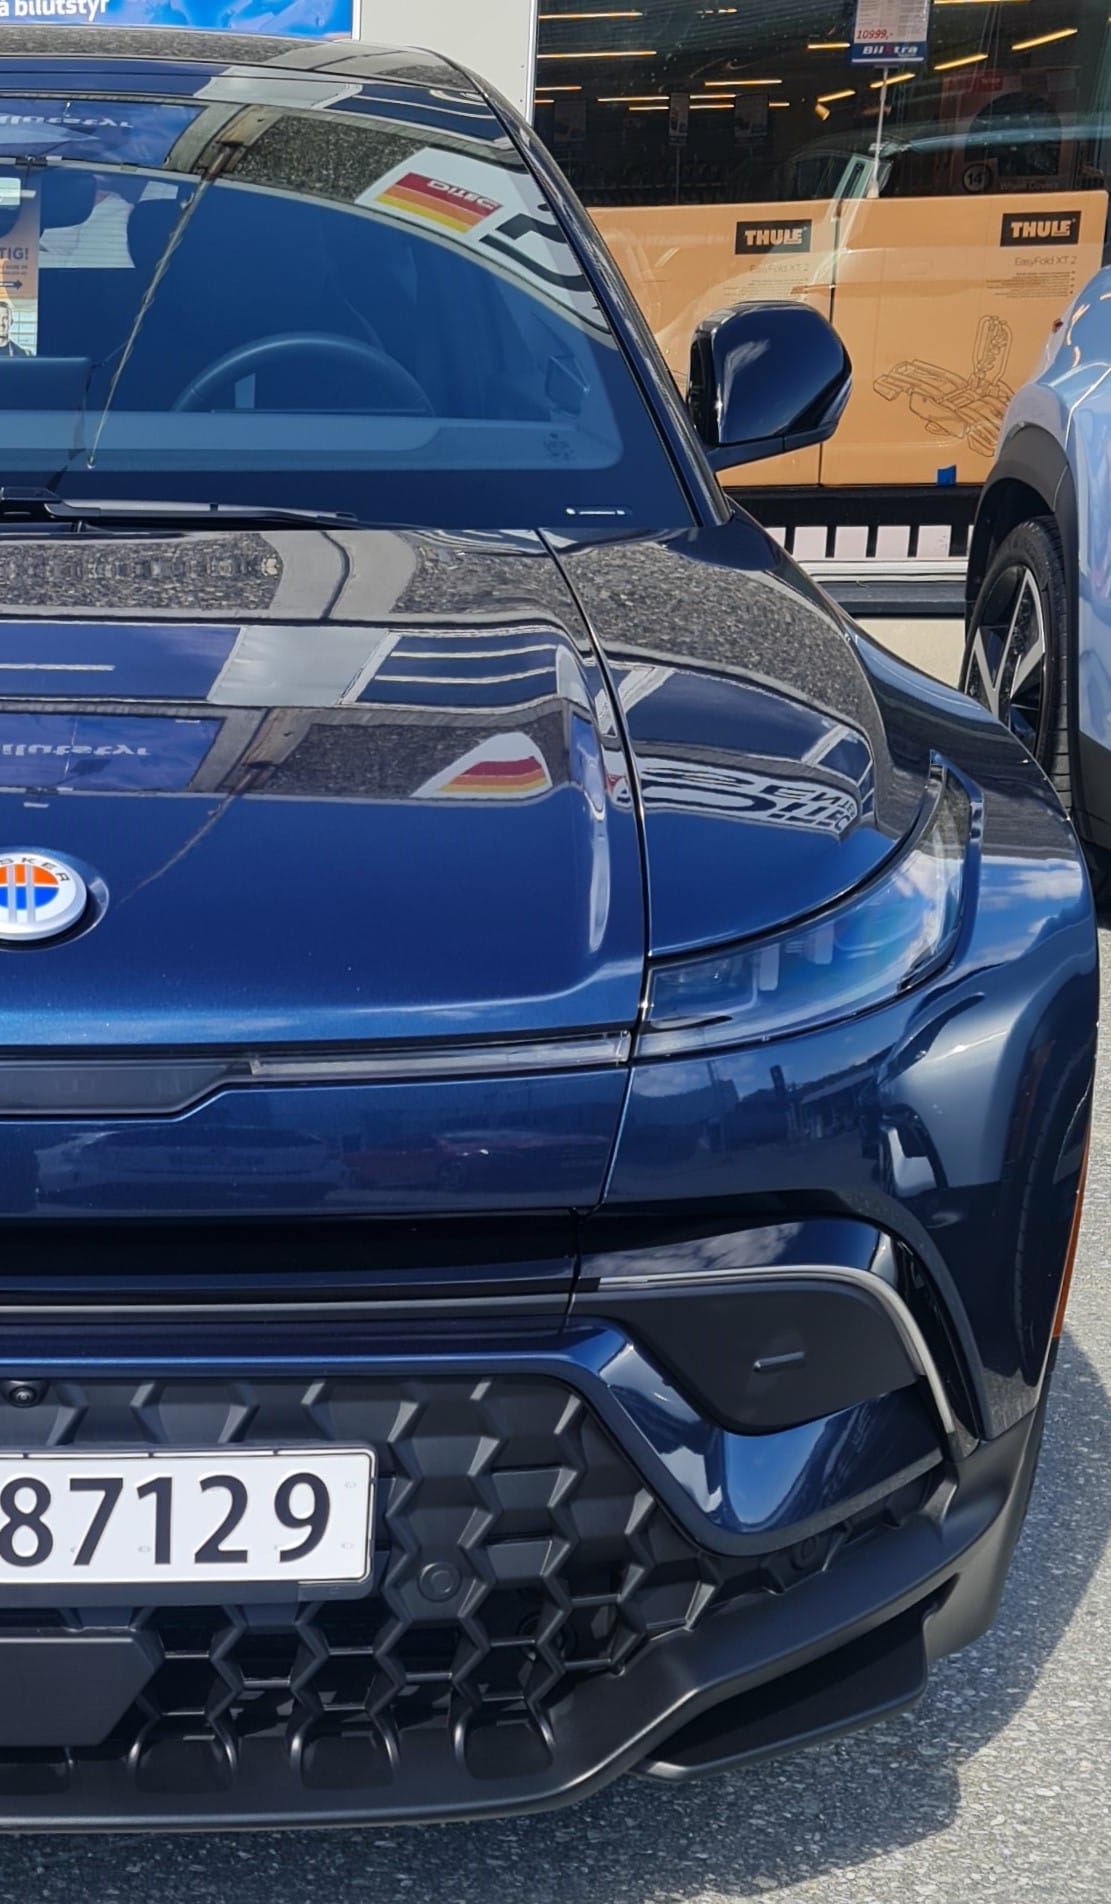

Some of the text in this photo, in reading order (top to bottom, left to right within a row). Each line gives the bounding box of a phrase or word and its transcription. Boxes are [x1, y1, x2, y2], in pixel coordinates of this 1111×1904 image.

[14, 0, 109, 21] bilutstyr
[744, 228, 803, 246] THULE
[1011, 219, 1072, 238] THULE
[1014, 255, 1078, 267] EasyFold XT 2
